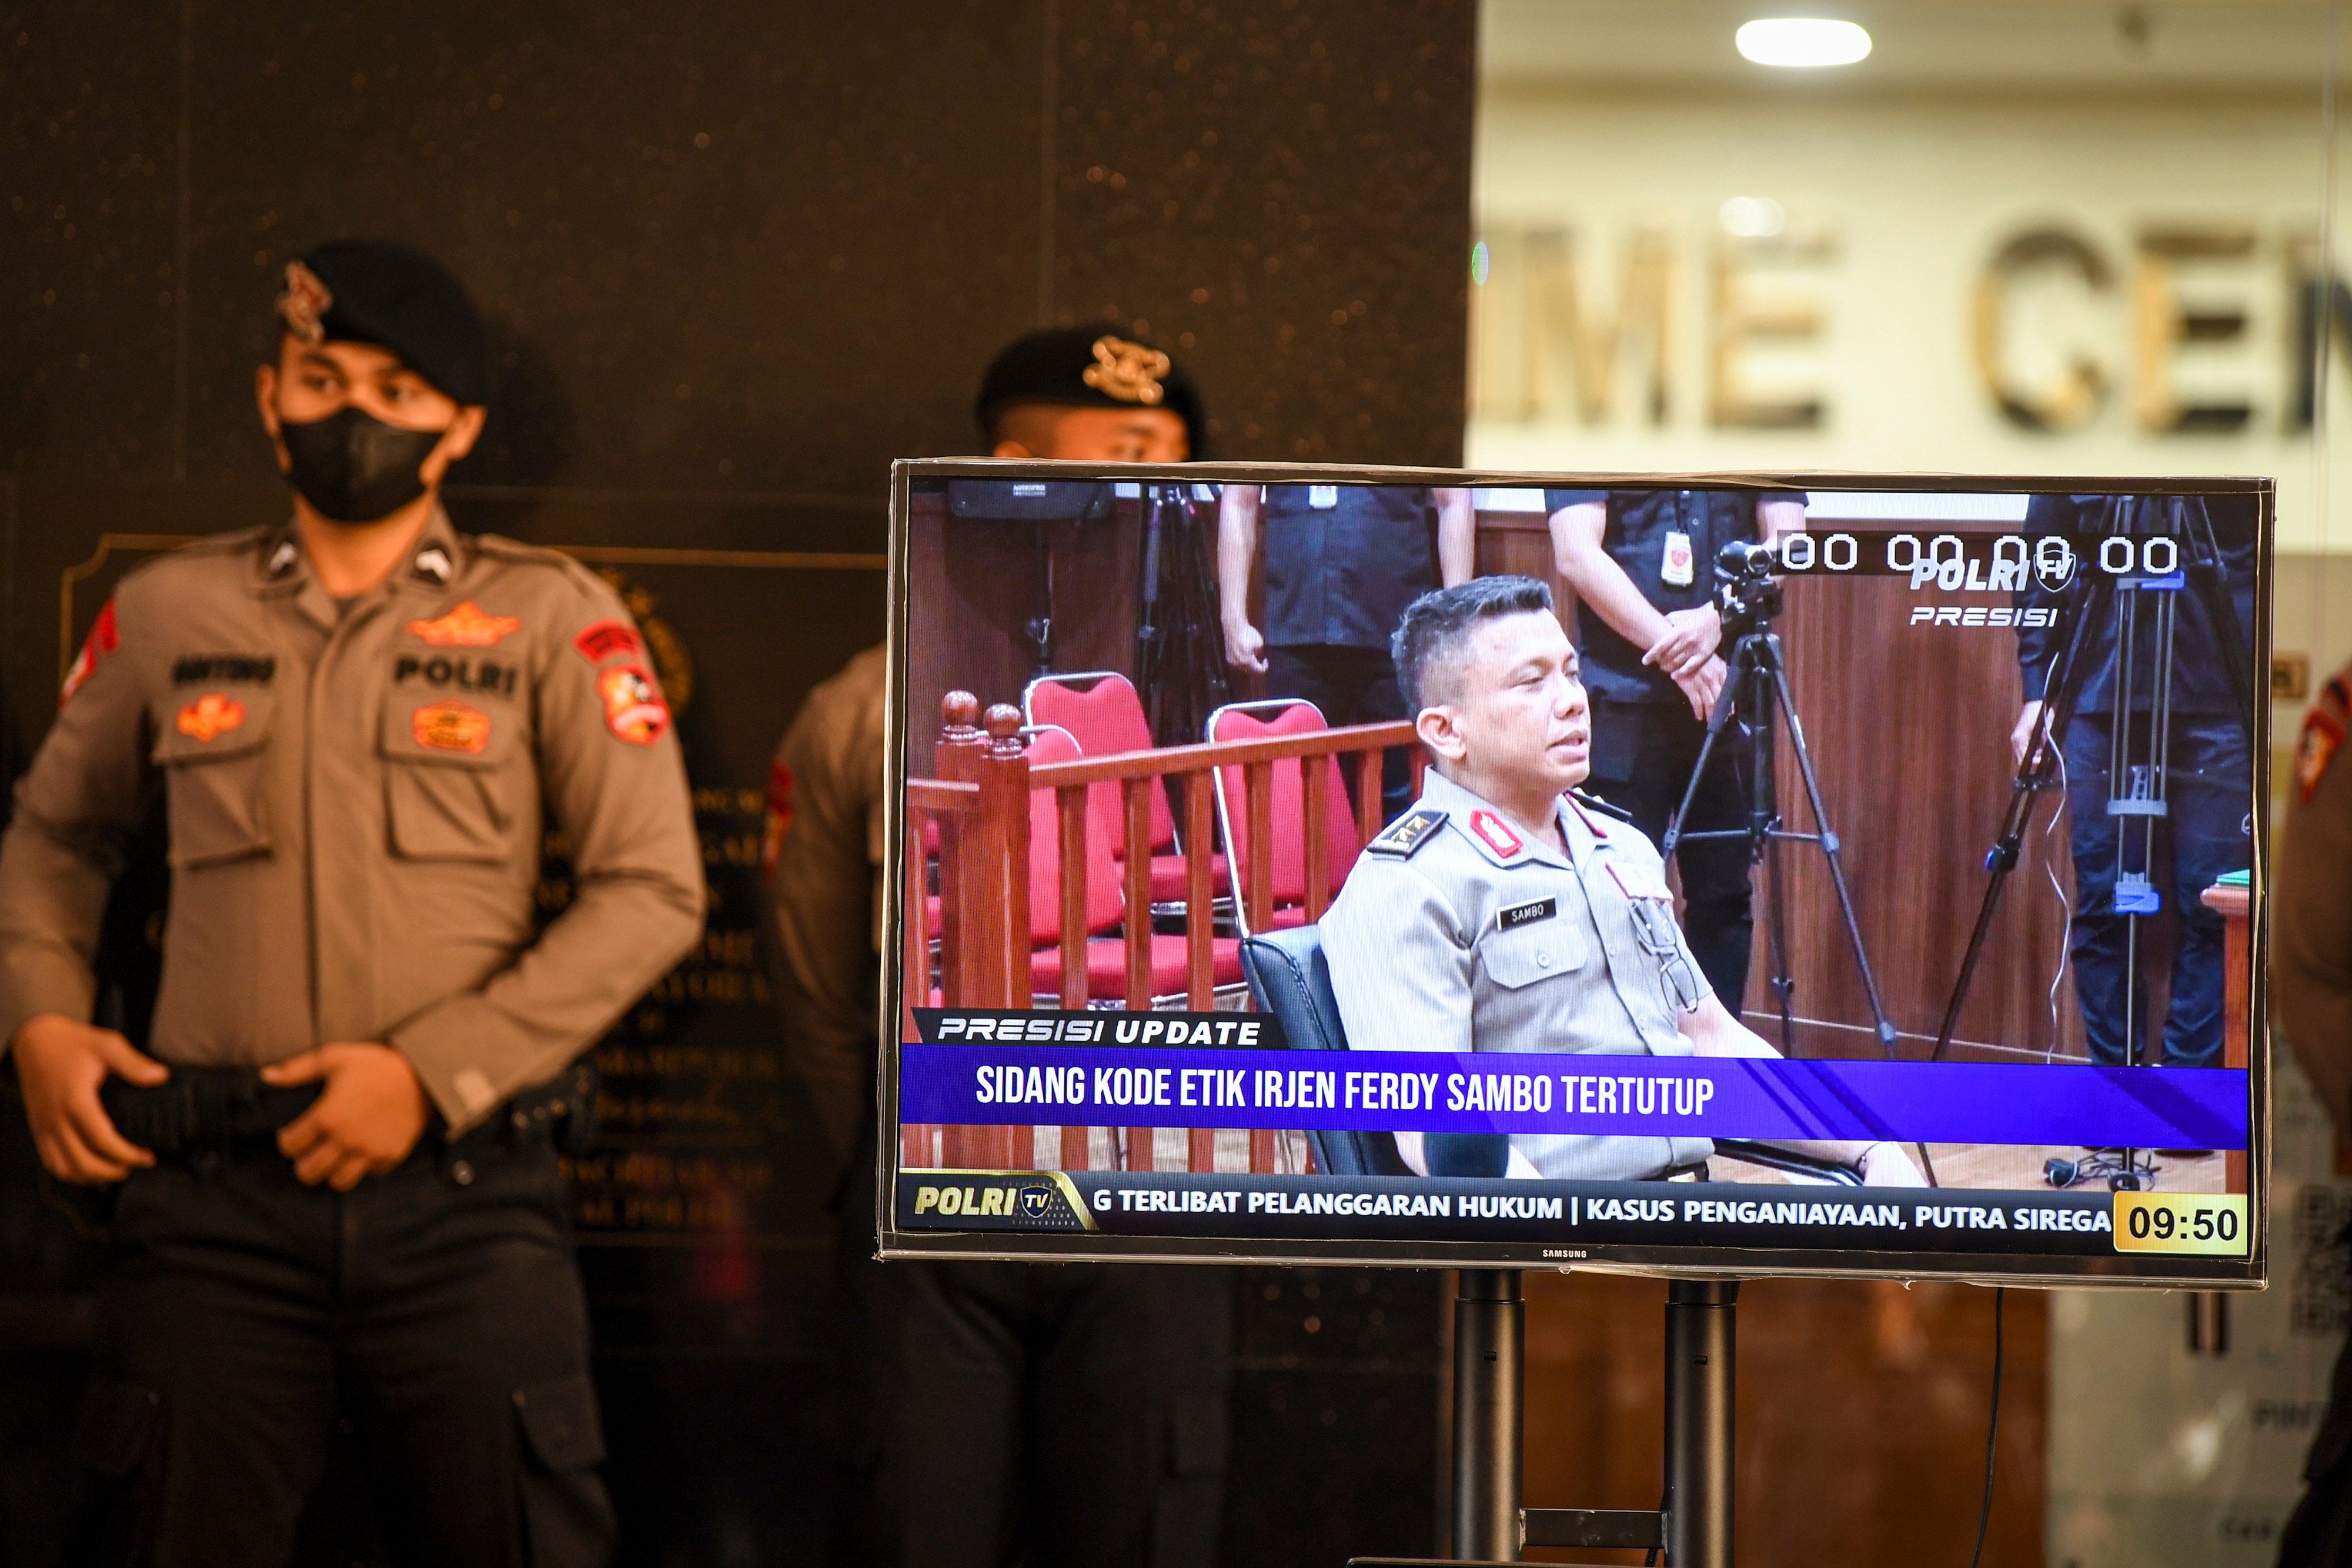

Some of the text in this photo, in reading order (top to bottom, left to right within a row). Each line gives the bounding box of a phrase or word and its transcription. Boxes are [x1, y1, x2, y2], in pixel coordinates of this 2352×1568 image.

[1910, 559, 2030, 591] POLRI
[1910, 606, 2058, 627] PRESISI
[393, 654, 517, 696] POLRI
[1511, 904, 1544, 922] SAMBO
[937, 1018, 1261, 1045] PRESISI UPDATE
[975, 1065, 1715, 1116] SIDANG KODE ETIK IRJEN FERDY SAMBO TERTUTUP
[914, 1186, 1051, 1216] POLRI TV
[1093, 1189, 1112, 1211] G
[1118, 1189, 1242, 1213] TERLIBAT
[1247, 1192, 1451, 1218] PELANGGARAN
[1458, 1196, 1563, 1219] HUKUM
[1586, 1198, 1675, 1222] KASUS
[1683, 1200, 1907, 1231] PENGANIAYAAN,
[1915, 1205, 2007, 1230] PUTRA
[2013, 1207, 2112, 1232] SIREGA
[2128, 1206, 2239, 1242] 09:50
[1542, 1249, 1588, 1258] SAMSUNG
